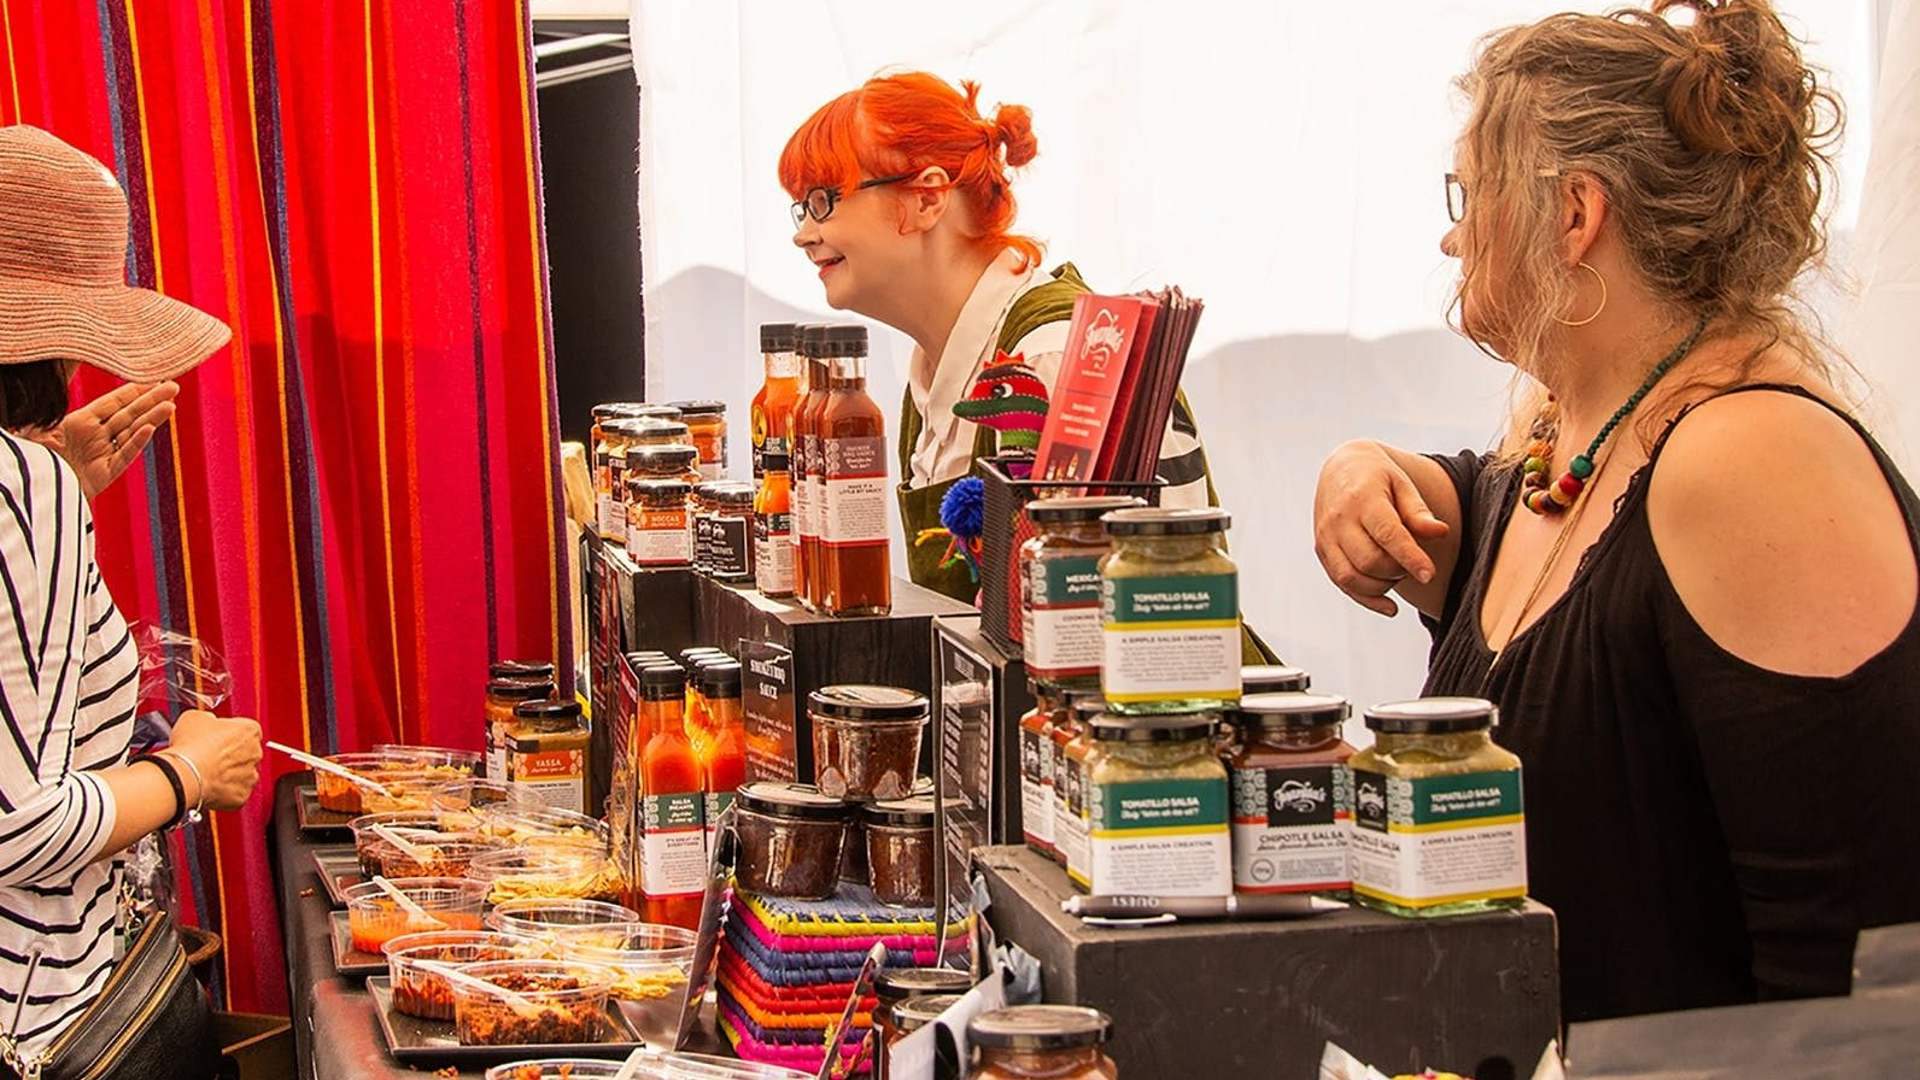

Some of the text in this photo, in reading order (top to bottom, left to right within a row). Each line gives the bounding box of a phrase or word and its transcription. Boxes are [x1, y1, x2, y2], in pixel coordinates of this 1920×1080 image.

[1066, 574, 1099, 583] MEXICA
[1132, 592, 1210, 603] TOMATILLO SALSA
[536, 758, 561, 767] YASSA
[1431, 787, 1501, 803] TOMATILLO SALSA
[1121, 797, 1199, 809] TOMATILLO SALSA
[1259, 830, 1344, 844] CHIPOTLE SALSA
[1428, 837, 1451, 845] SIMPLE
[1453, 834, 1475, 843] SALSA
